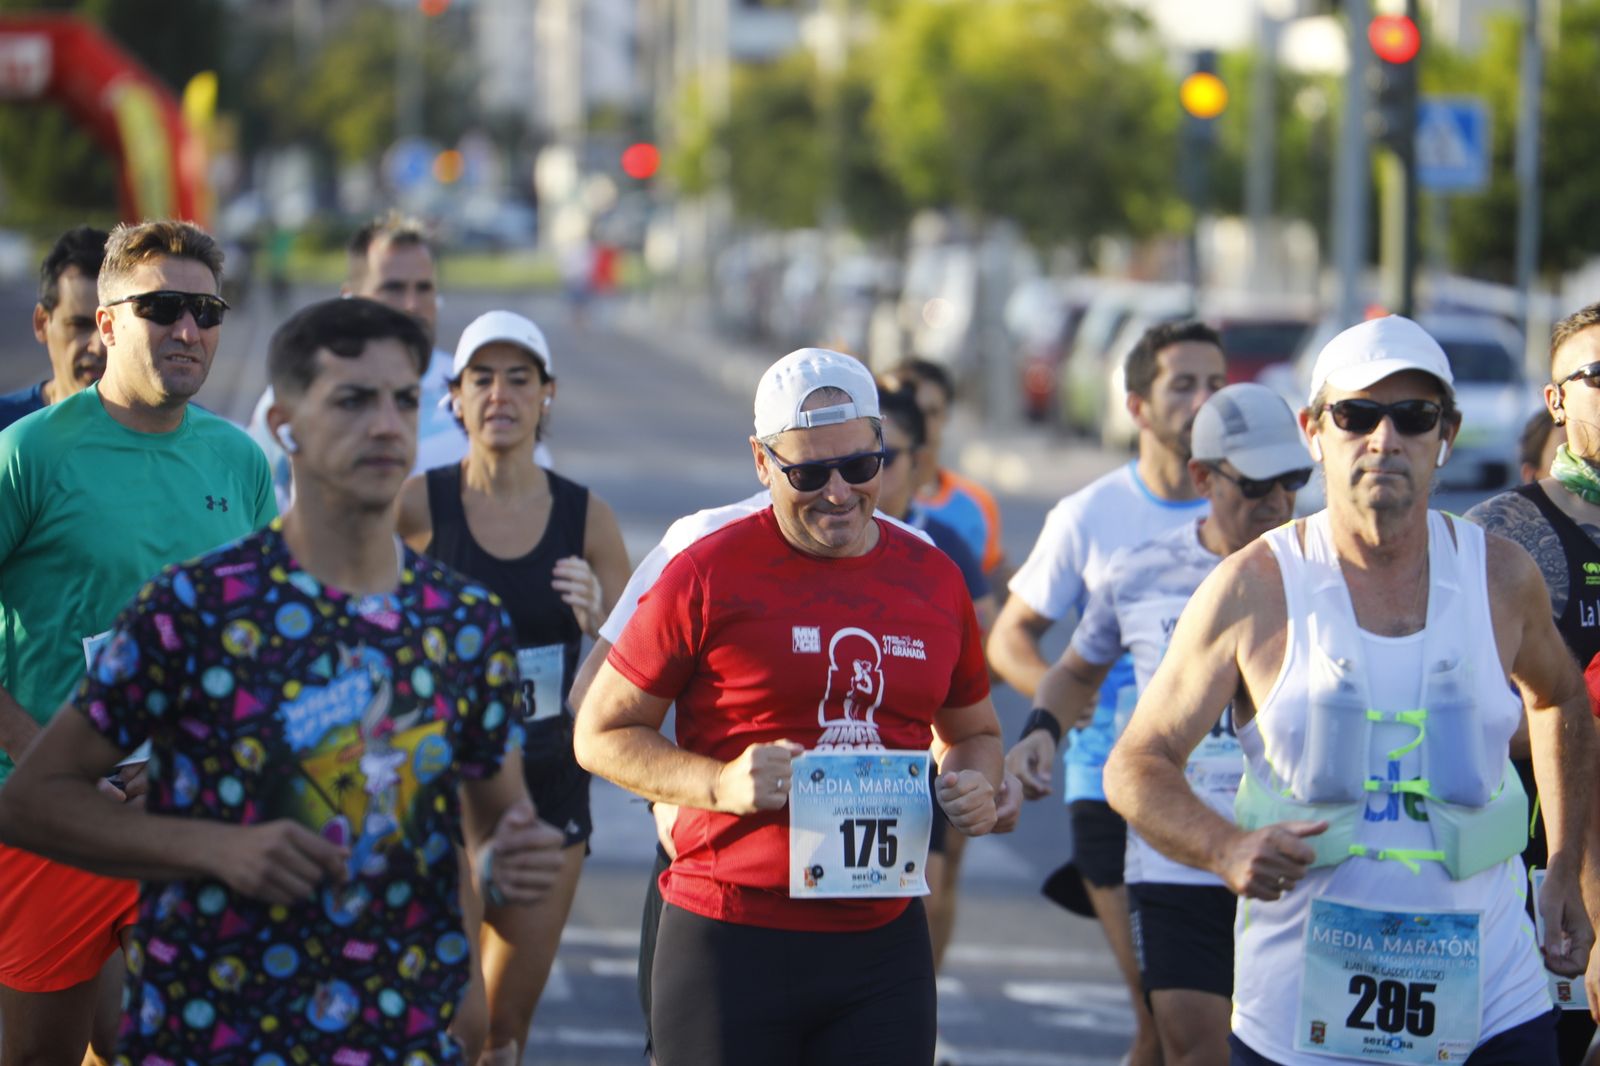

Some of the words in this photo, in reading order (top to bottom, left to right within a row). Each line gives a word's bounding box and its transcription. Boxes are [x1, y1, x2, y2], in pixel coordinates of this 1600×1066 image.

[892, 646, 926, 660] GRANADA
[798, 778, 853, 795] MEDIA
[860, 775, 924, 794] MARATÓN
[839, 819, 898, 868] 175
[1312, 926, 1375, 951] MEDIA
[1383, 936, 1477, 957] MARATÓN
[1346, 974, 1437, 1037] 295
